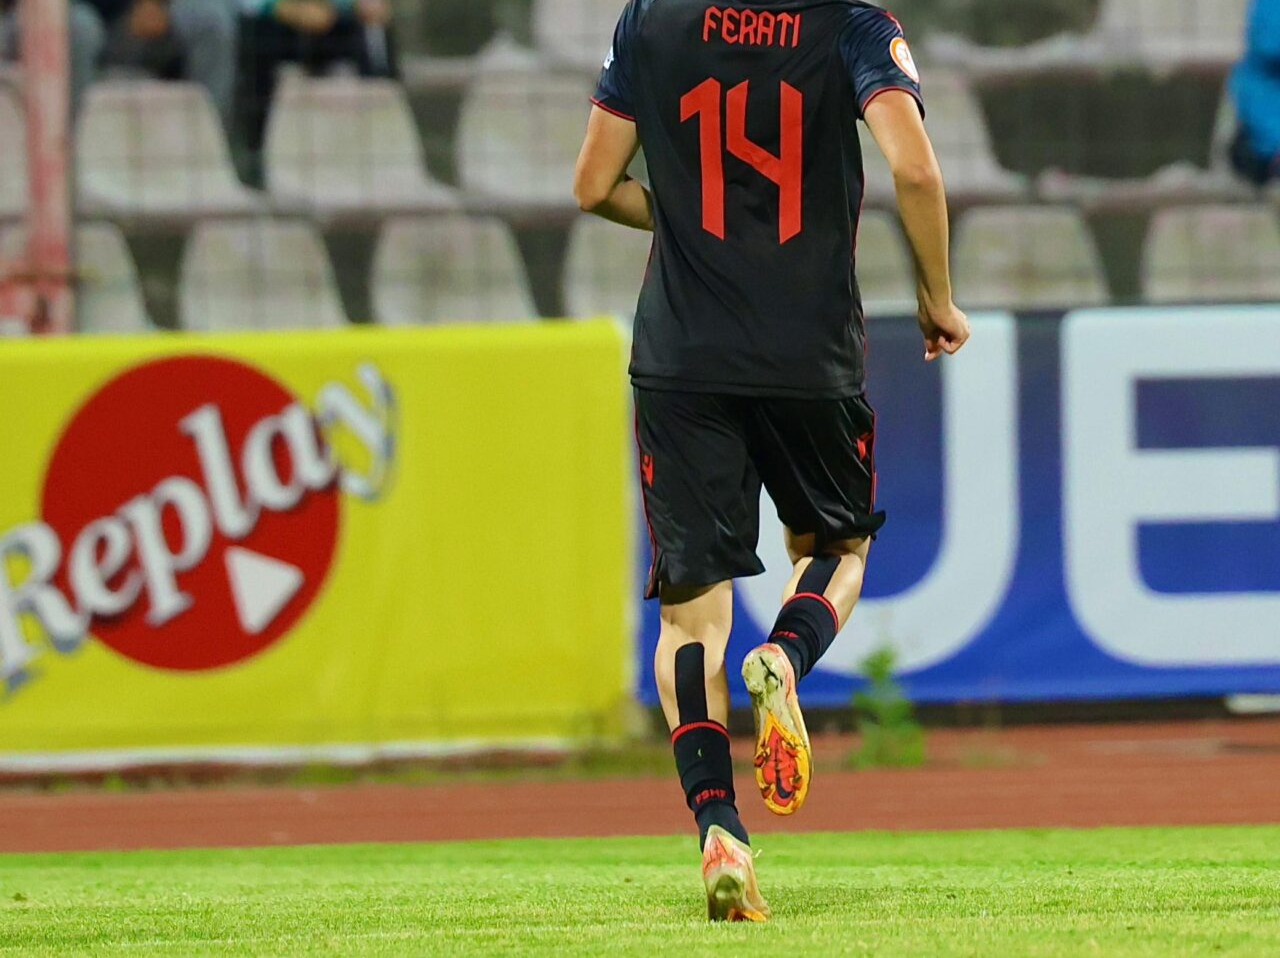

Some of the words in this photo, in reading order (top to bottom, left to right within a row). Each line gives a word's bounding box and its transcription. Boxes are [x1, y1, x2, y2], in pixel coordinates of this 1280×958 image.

[703, 6, 802, 48] FERATI
[680, 76, 803, 244] 14
[0, 362, 393, 682] Replay
